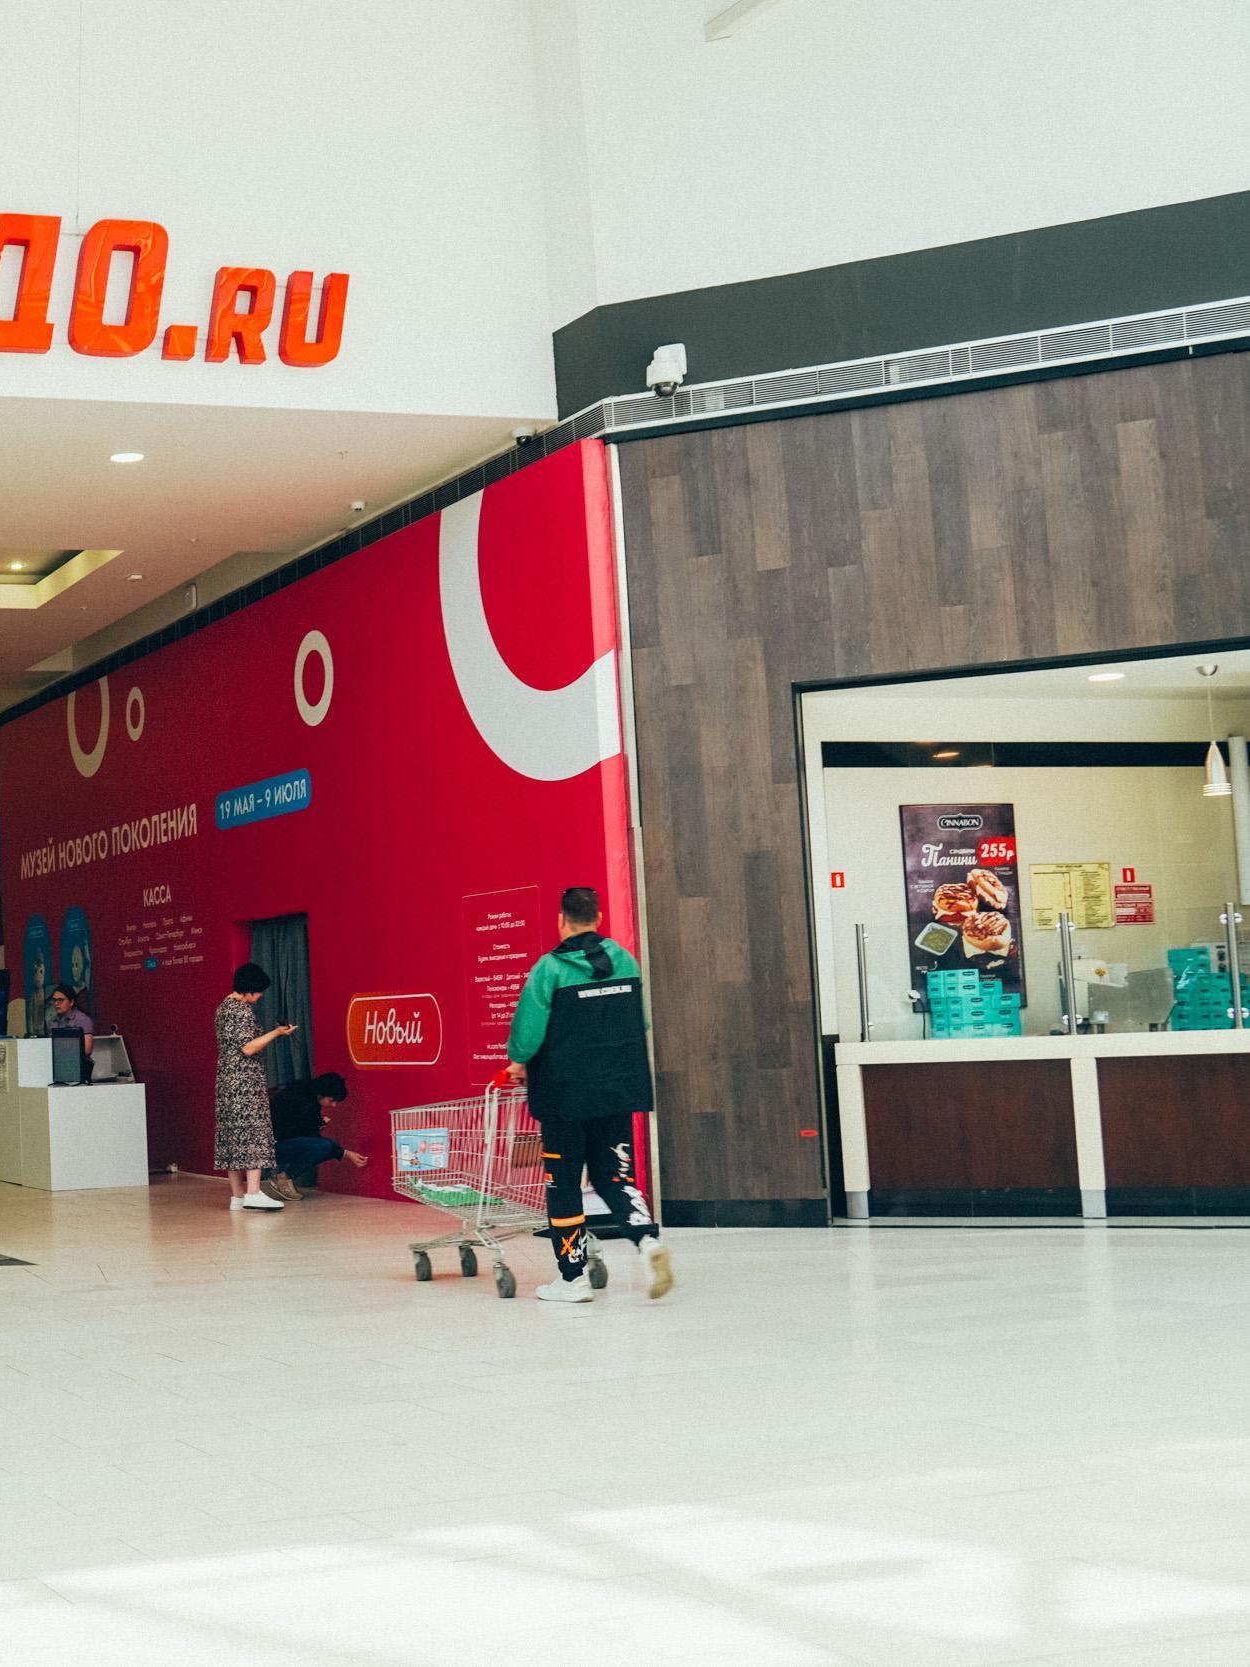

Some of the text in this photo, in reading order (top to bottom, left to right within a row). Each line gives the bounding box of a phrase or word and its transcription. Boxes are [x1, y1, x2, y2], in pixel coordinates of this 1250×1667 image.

[219, 800, 231, 820] 19
[233, 793, 255, 816] МАЯ
[264, 791, 272, 808] 9
[273, 778, 307, 805] ИЮЛЯ
[940, 818, 980, 827] CINNABON
[20, 803, 198, 880] МУЗЕЙ НОВОГО ПОКОЛЕНИЯ
[921, 843, 978, 867] Панини
[143, 885, 172, 907] КАССА
[363, 1007, 423, 1045] Новый
